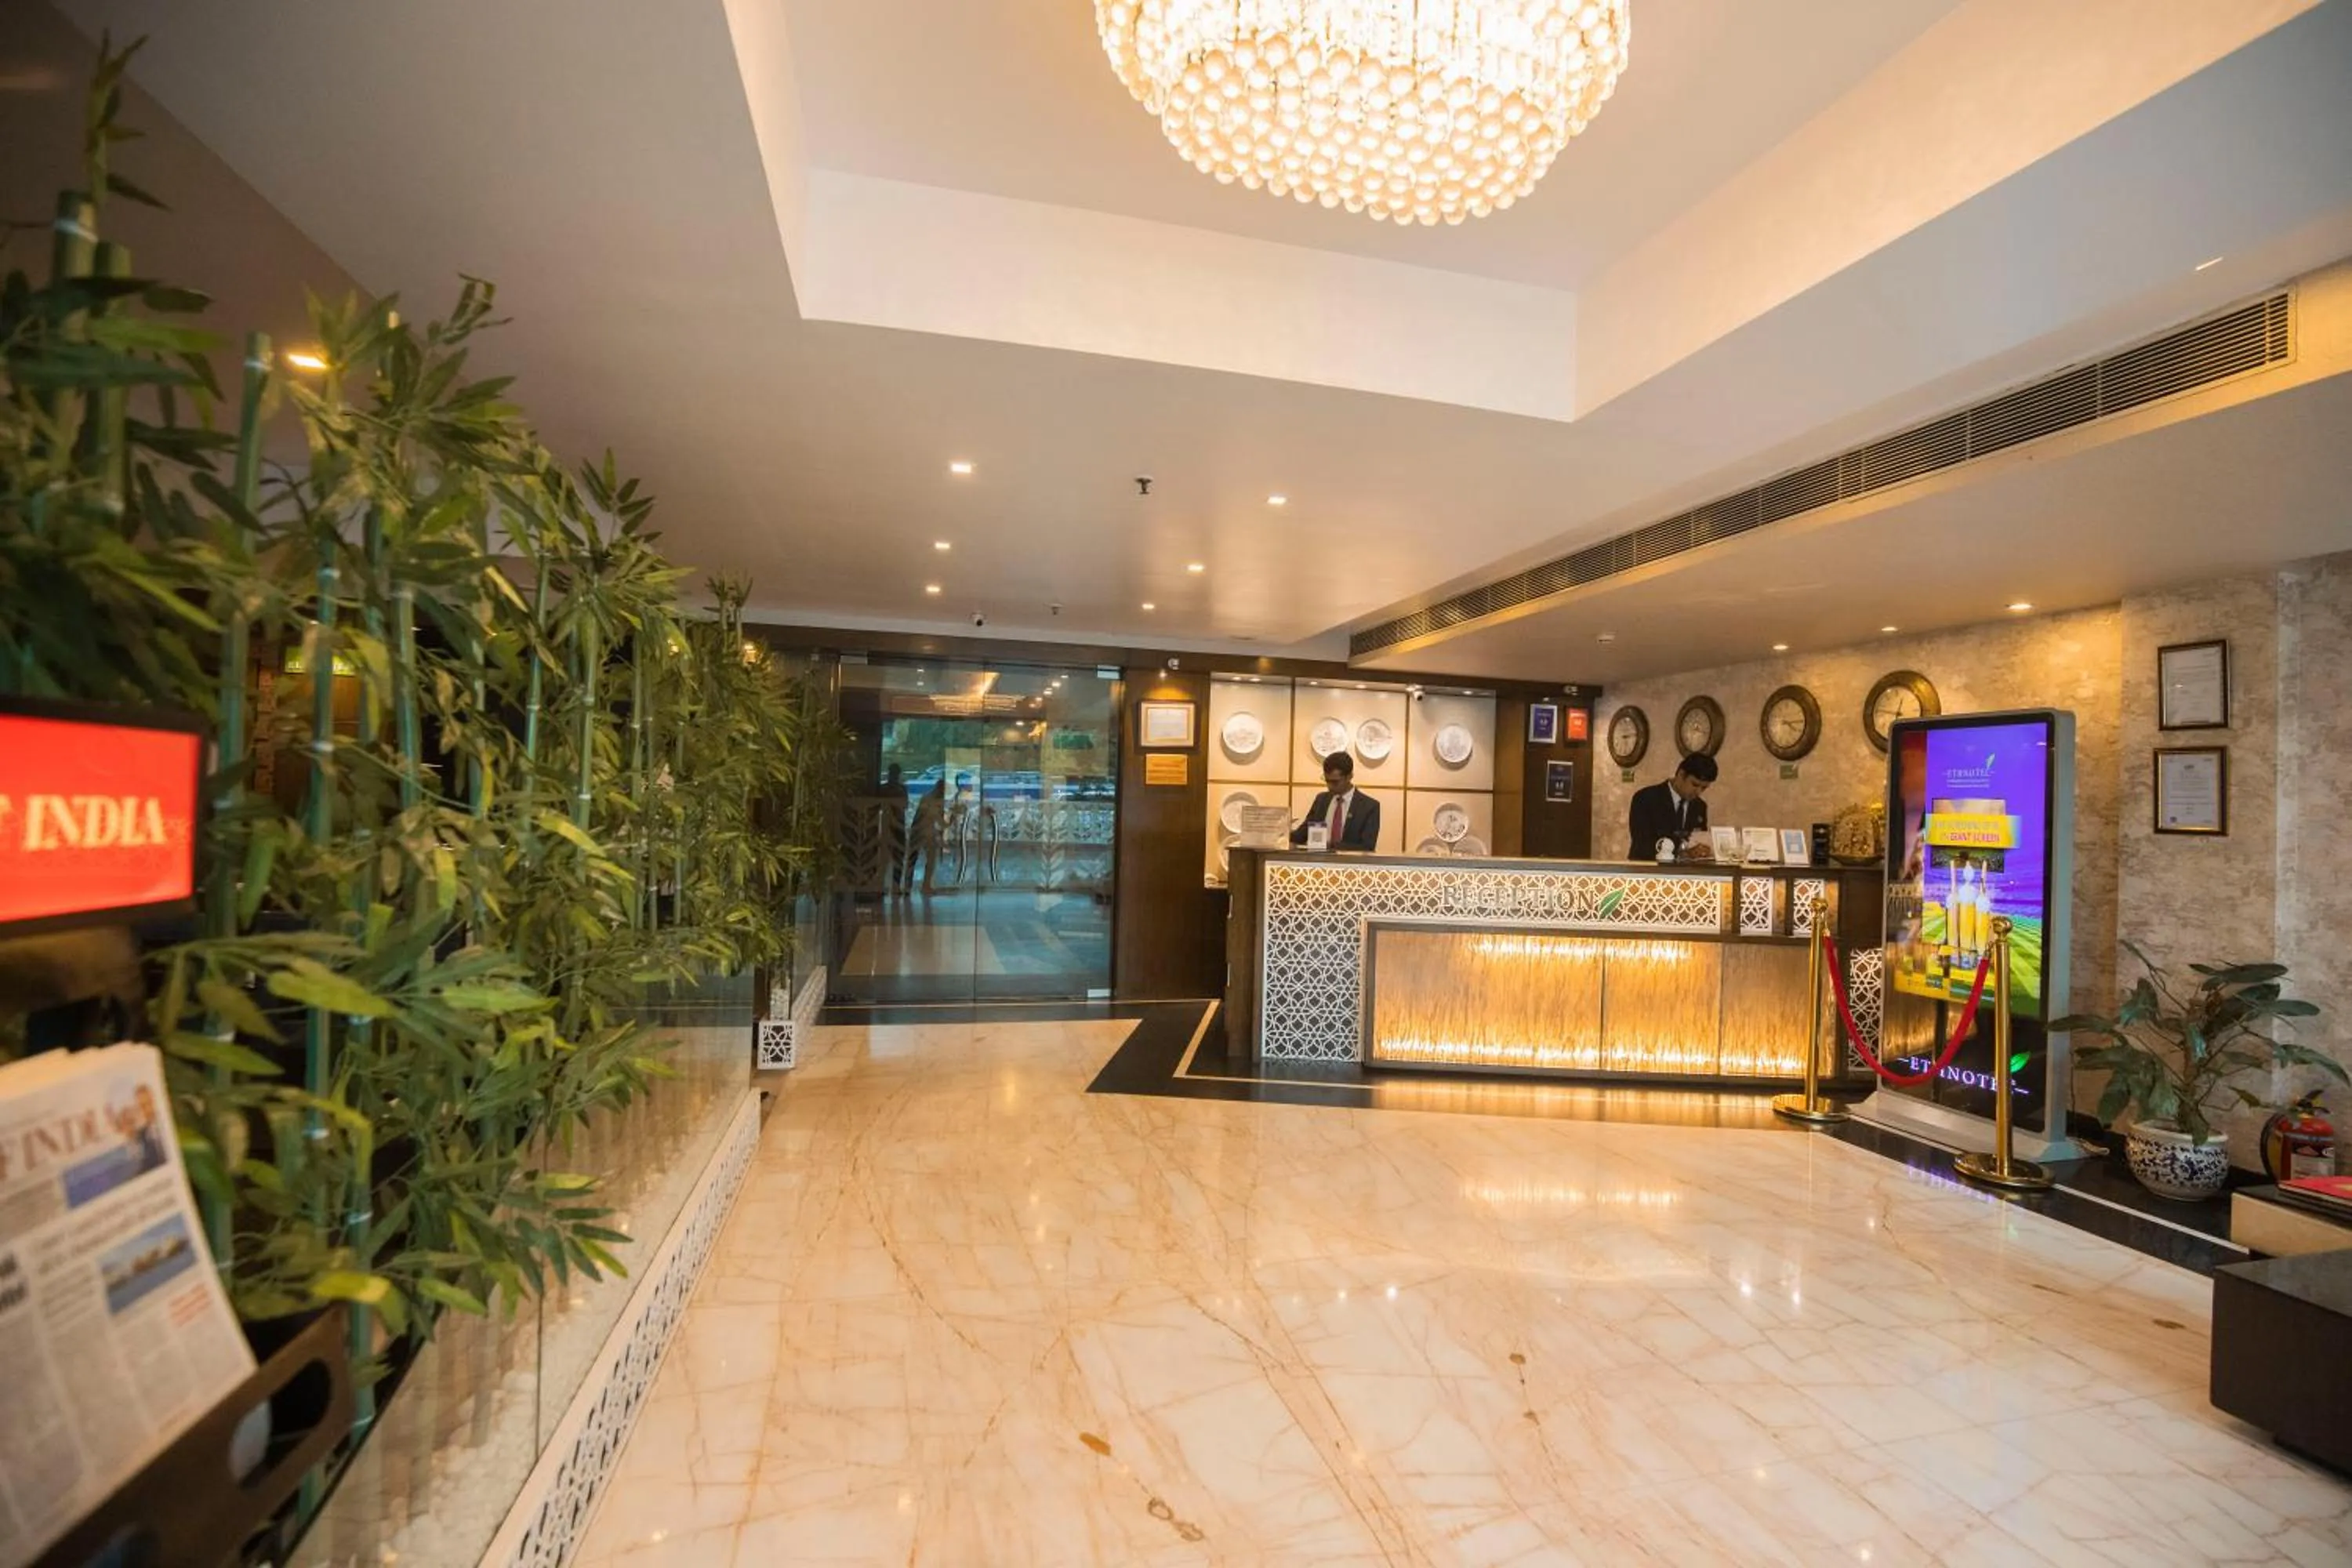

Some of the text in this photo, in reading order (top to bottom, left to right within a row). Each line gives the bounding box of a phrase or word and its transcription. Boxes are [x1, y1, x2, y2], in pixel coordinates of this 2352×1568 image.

[22, 793, 168, 851] INDIA
[1443, 885, 1596, 913] RECEPTION
[1911, 1056, 2013, 1094] ETNOTE
